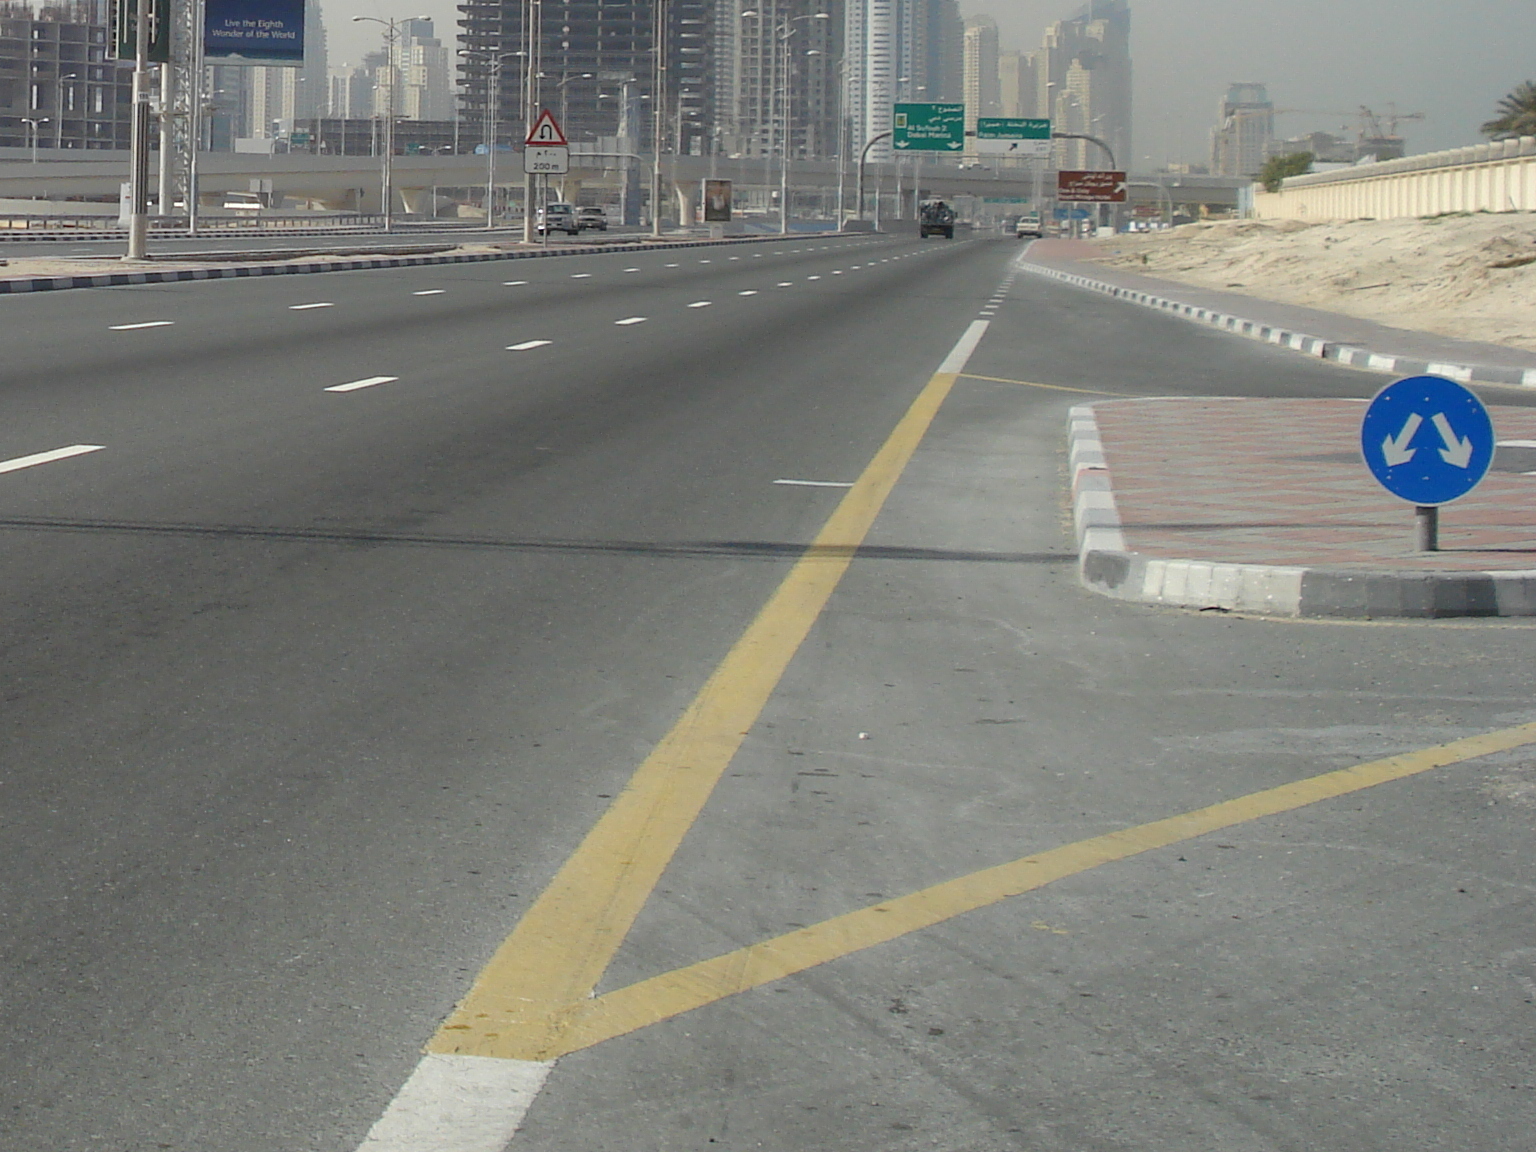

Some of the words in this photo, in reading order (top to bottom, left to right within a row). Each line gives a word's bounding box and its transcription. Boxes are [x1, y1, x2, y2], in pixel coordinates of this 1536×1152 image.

[224, 19, 241, 28] Live
[242, 19, 256, 28] the
[257, 19, 284, 30] Eighth
[212, 29, 244, 38] Wonder
[245, 30, 254, 38] of
[256, 30, 270, 39] the
[271, 31, 296, 40] World
